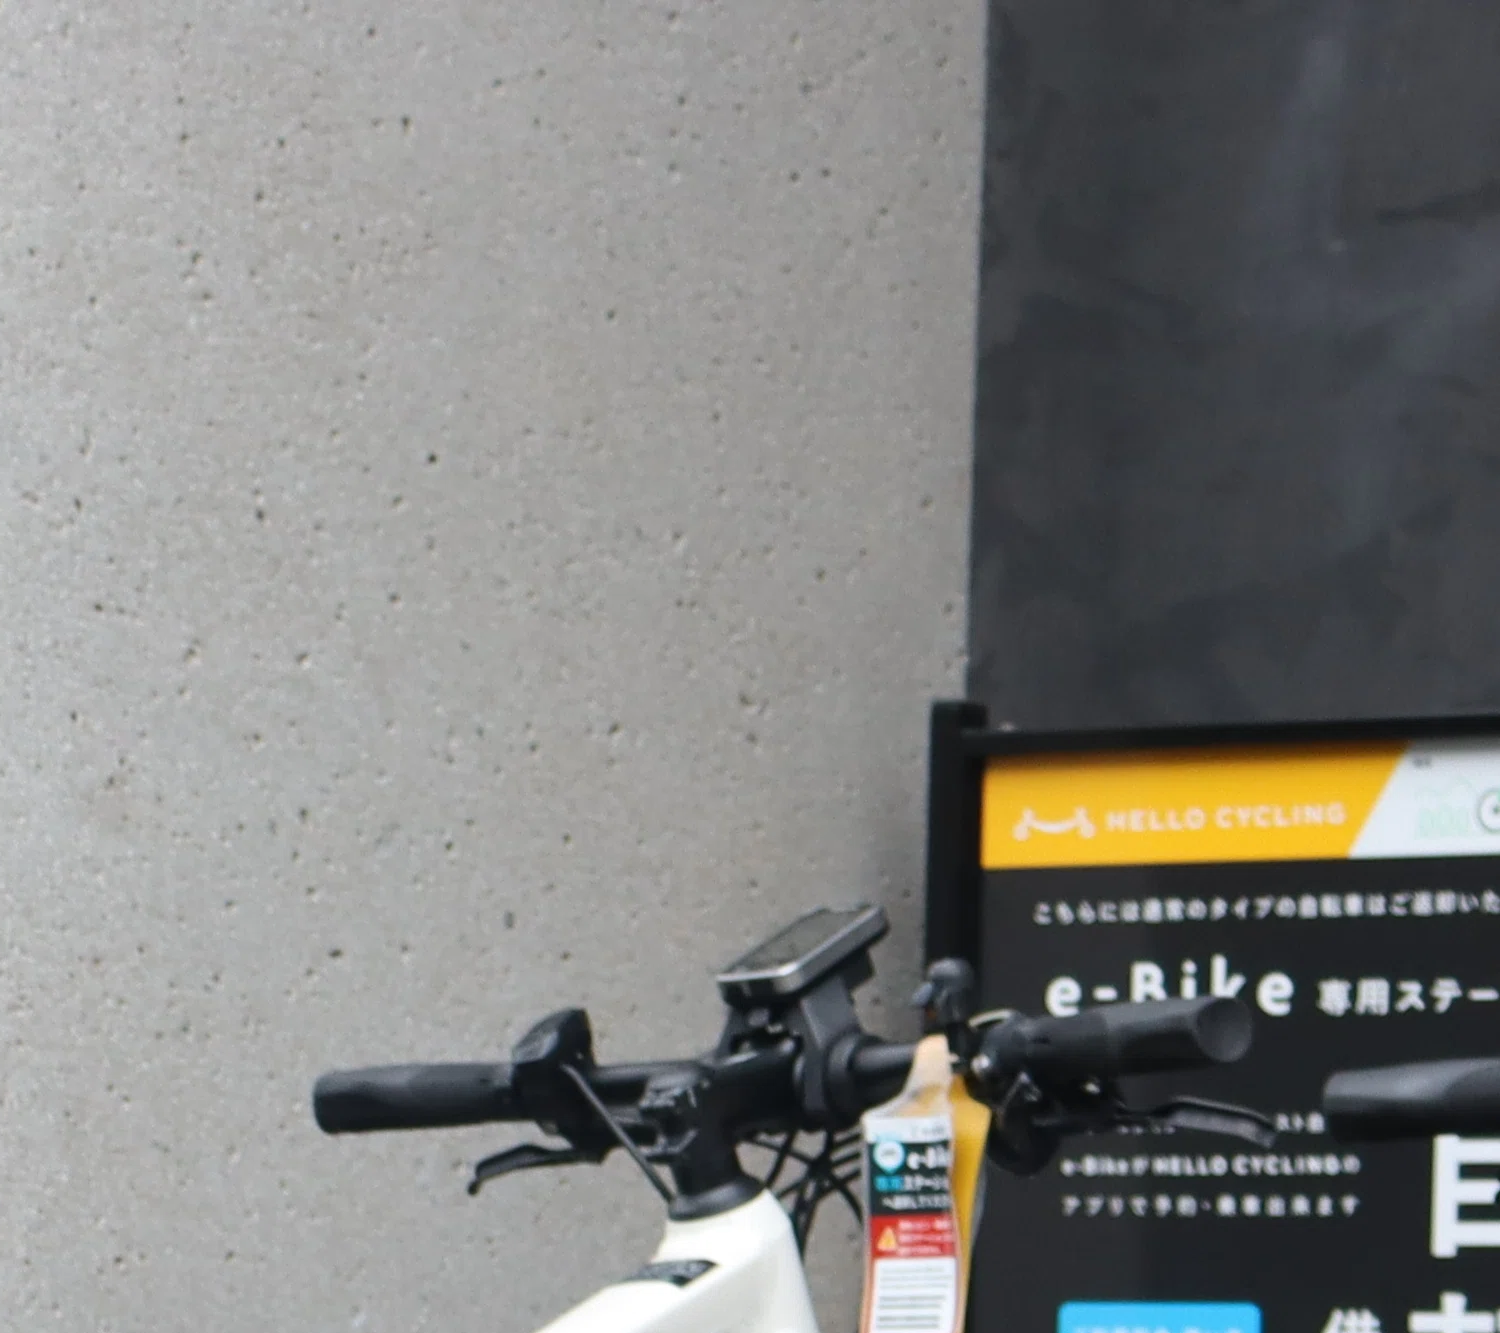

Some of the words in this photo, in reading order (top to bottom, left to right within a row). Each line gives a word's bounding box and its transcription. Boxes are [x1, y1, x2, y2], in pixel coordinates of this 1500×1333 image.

[1105, 807, 1206, 832] HELLO
[1215, 802, 1347, 828] CYCLING
[1045, 954, 1294, 1017] e-Bike
[1151, 1154, 1229, 1177] HELLO
